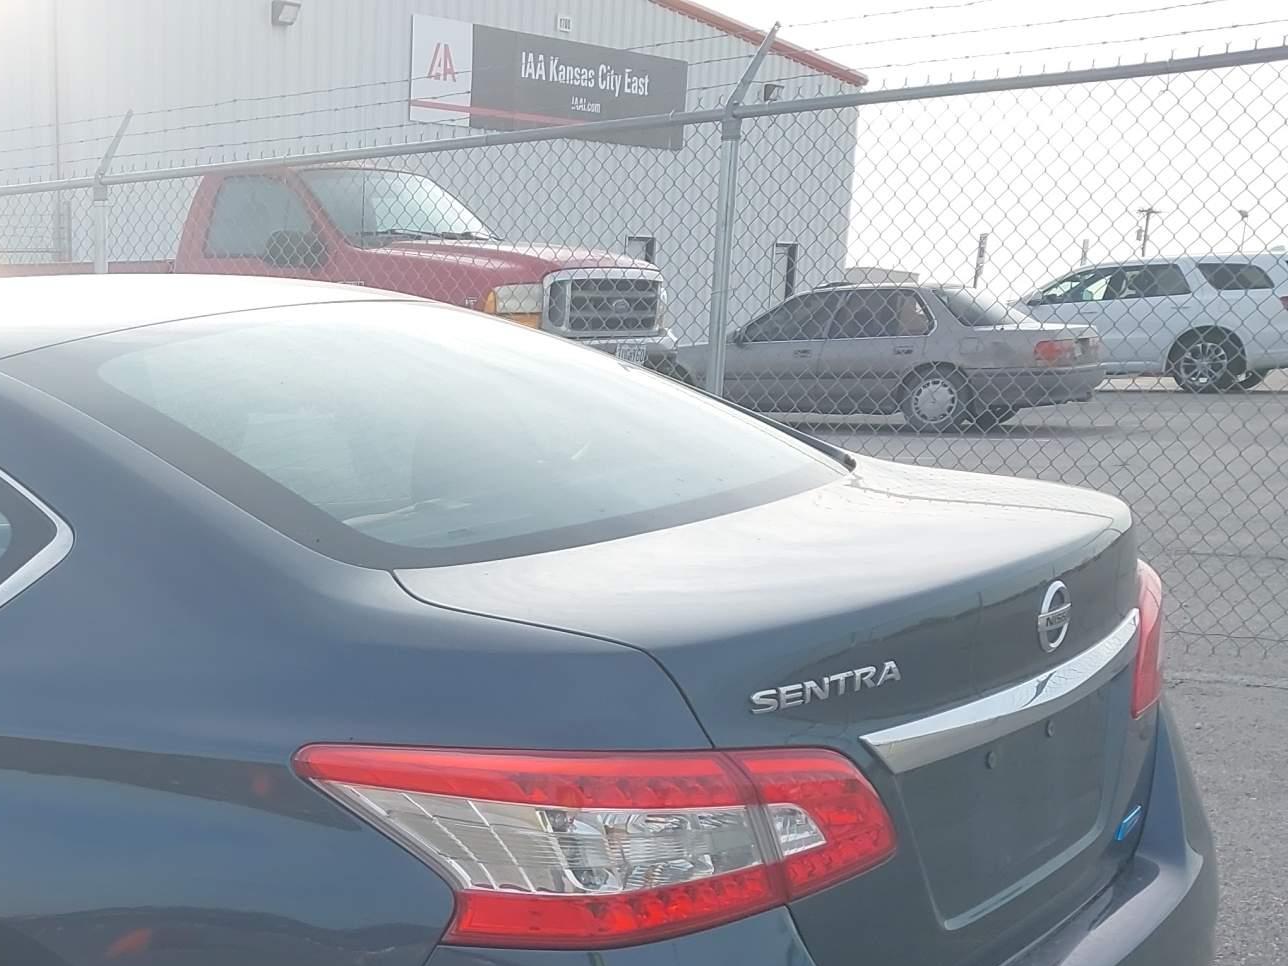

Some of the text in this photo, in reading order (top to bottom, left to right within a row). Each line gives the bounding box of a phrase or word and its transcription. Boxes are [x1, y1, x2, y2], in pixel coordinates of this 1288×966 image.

[520, 51, 650, 98] IAA Kansas City East
[750, 660, 902, 715] SENTRA
